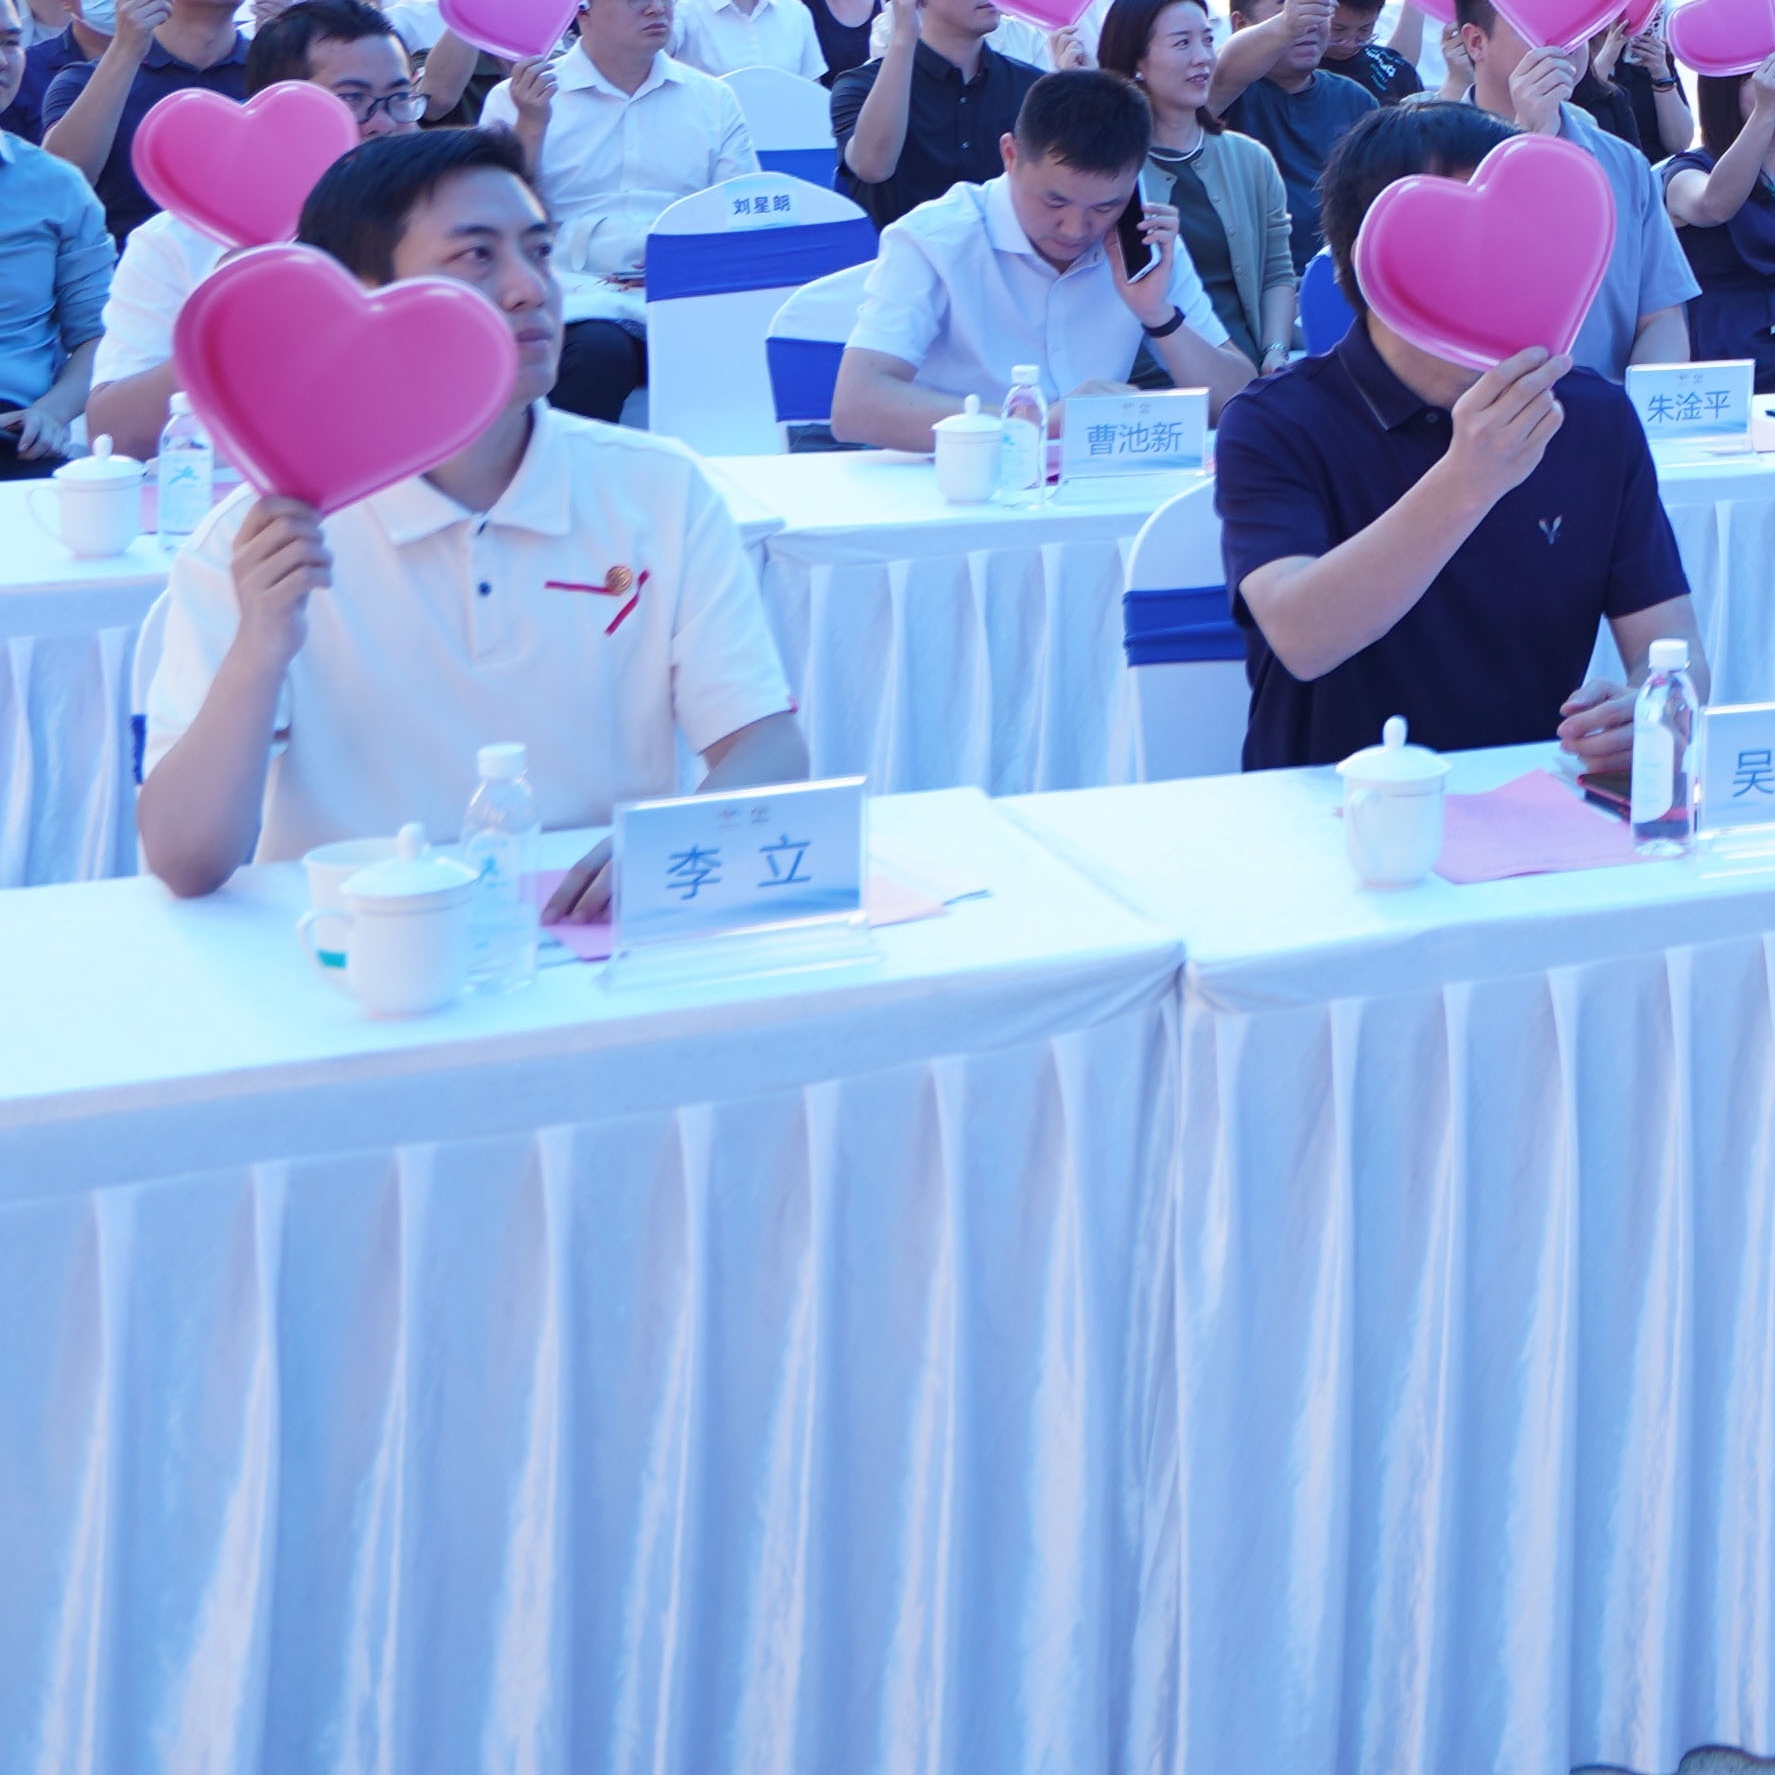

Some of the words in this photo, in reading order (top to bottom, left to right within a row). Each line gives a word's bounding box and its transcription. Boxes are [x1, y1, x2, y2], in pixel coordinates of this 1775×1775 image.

[1646, 389, 1732, 424] 朱淦平
[1084, 421, 1184, 456] 曹池新
